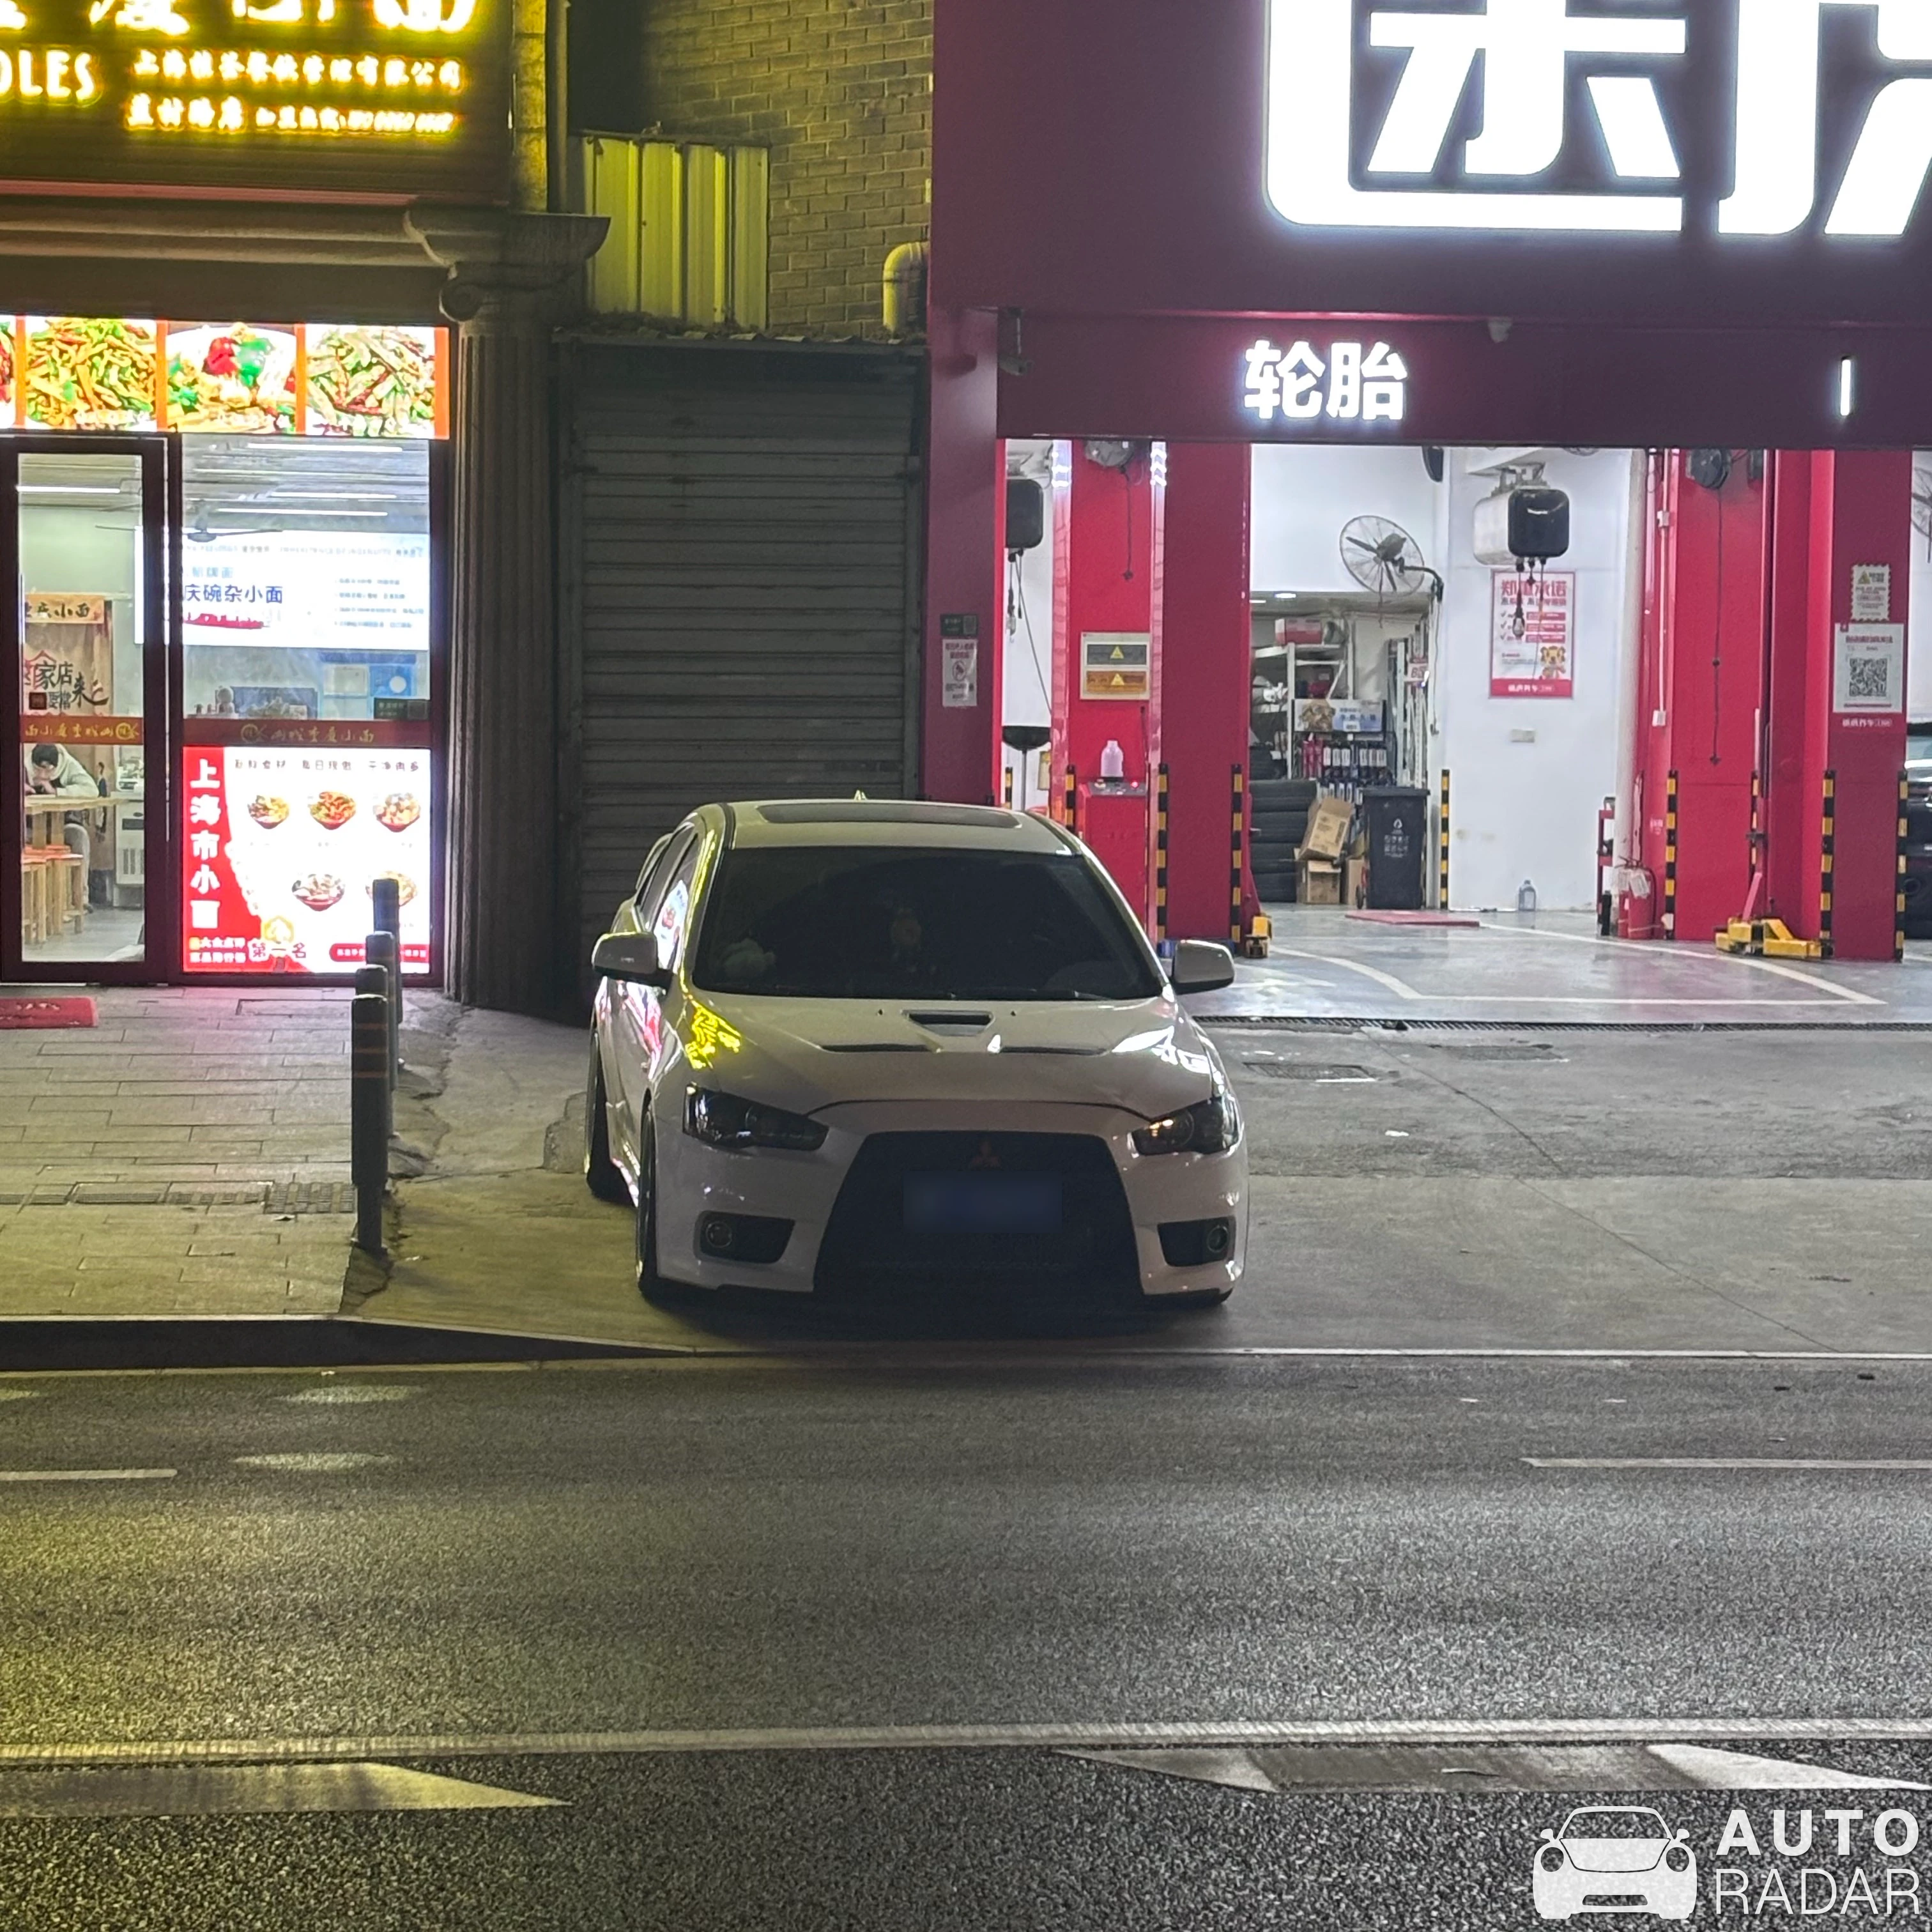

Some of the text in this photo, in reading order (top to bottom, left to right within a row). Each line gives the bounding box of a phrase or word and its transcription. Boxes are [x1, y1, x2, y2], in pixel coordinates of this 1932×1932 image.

[1243, 339, 1408, 420] 轮胎
[252, 942, 307, 959] 第一名
